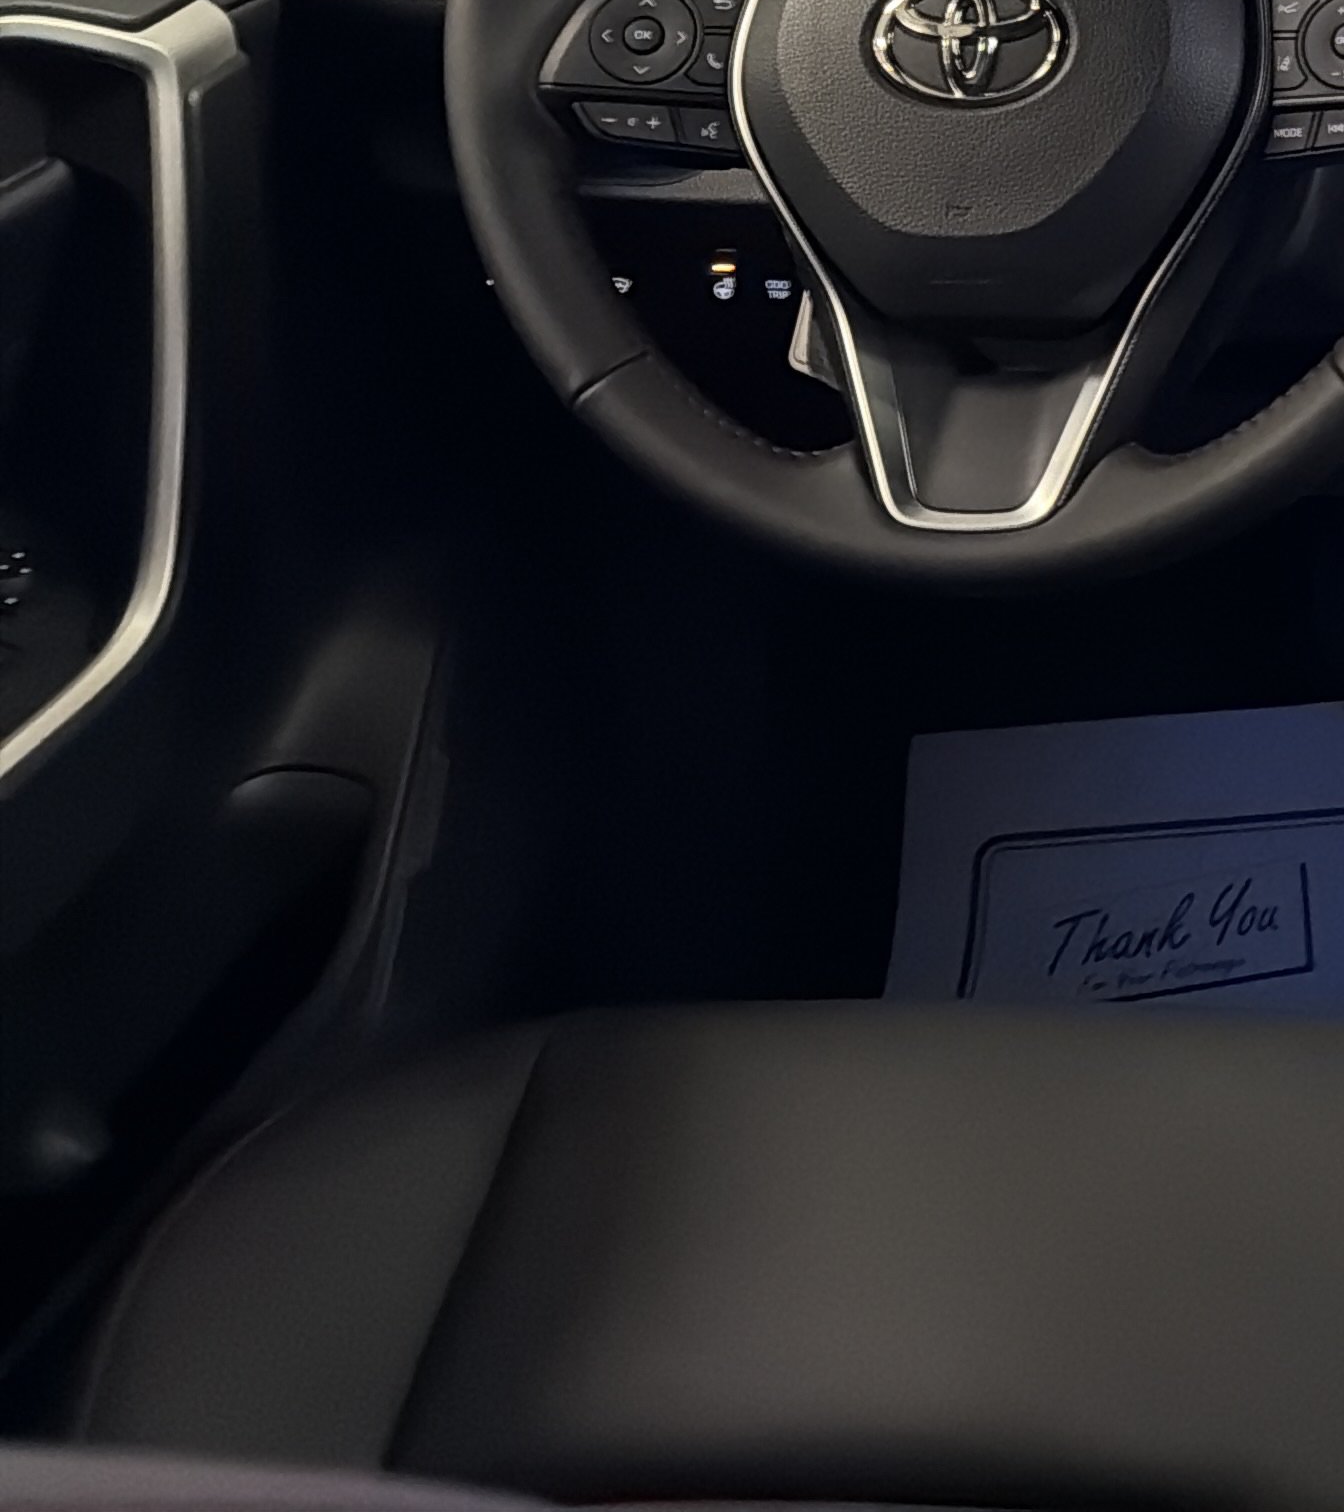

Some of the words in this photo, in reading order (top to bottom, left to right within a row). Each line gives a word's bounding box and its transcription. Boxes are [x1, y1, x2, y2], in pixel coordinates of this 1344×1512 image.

[634, 29, 652, 41] OK
[1273, 127, 1303, 139] MODE
[1046, 891, 1195, 977] Thank
[1208, 877, 1280, 947] You
